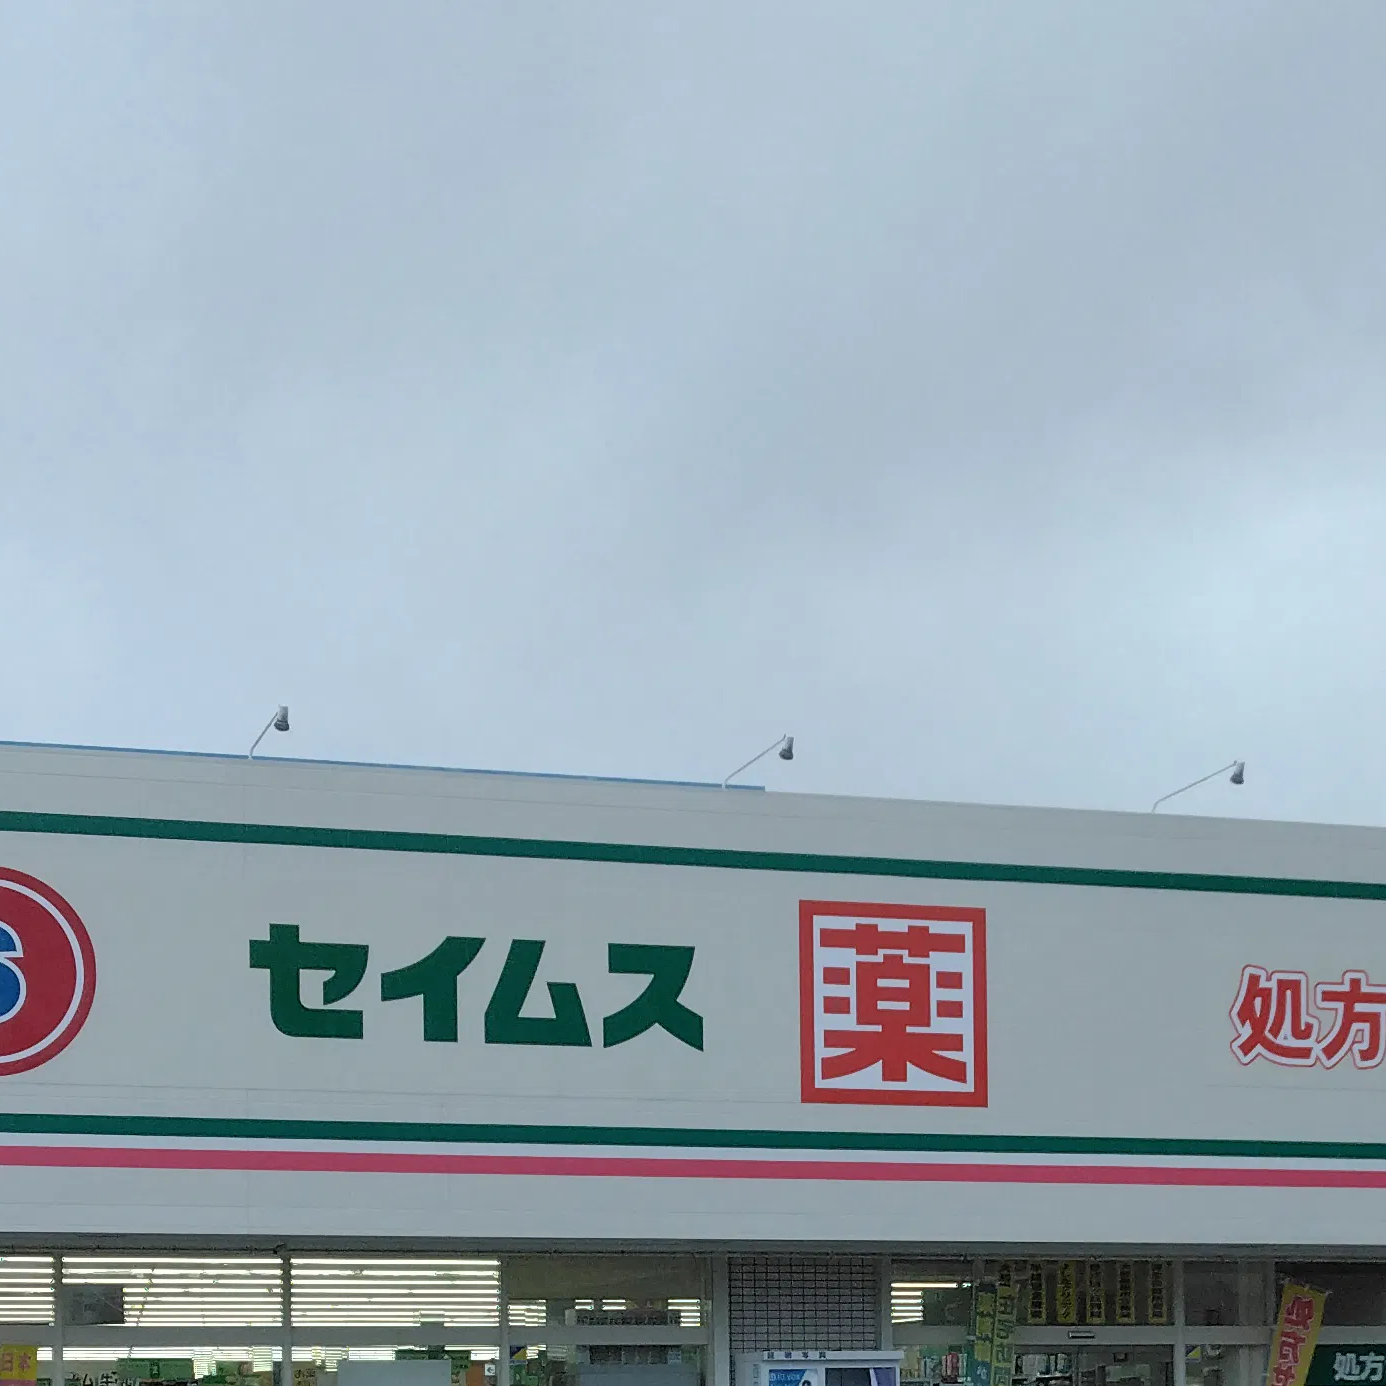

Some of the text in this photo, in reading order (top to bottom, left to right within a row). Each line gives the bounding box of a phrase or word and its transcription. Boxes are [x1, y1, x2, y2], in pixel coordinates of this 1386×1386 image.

[249, 924, 704, 1052] セイムス
[818, 922, 969, 1084] 薬
